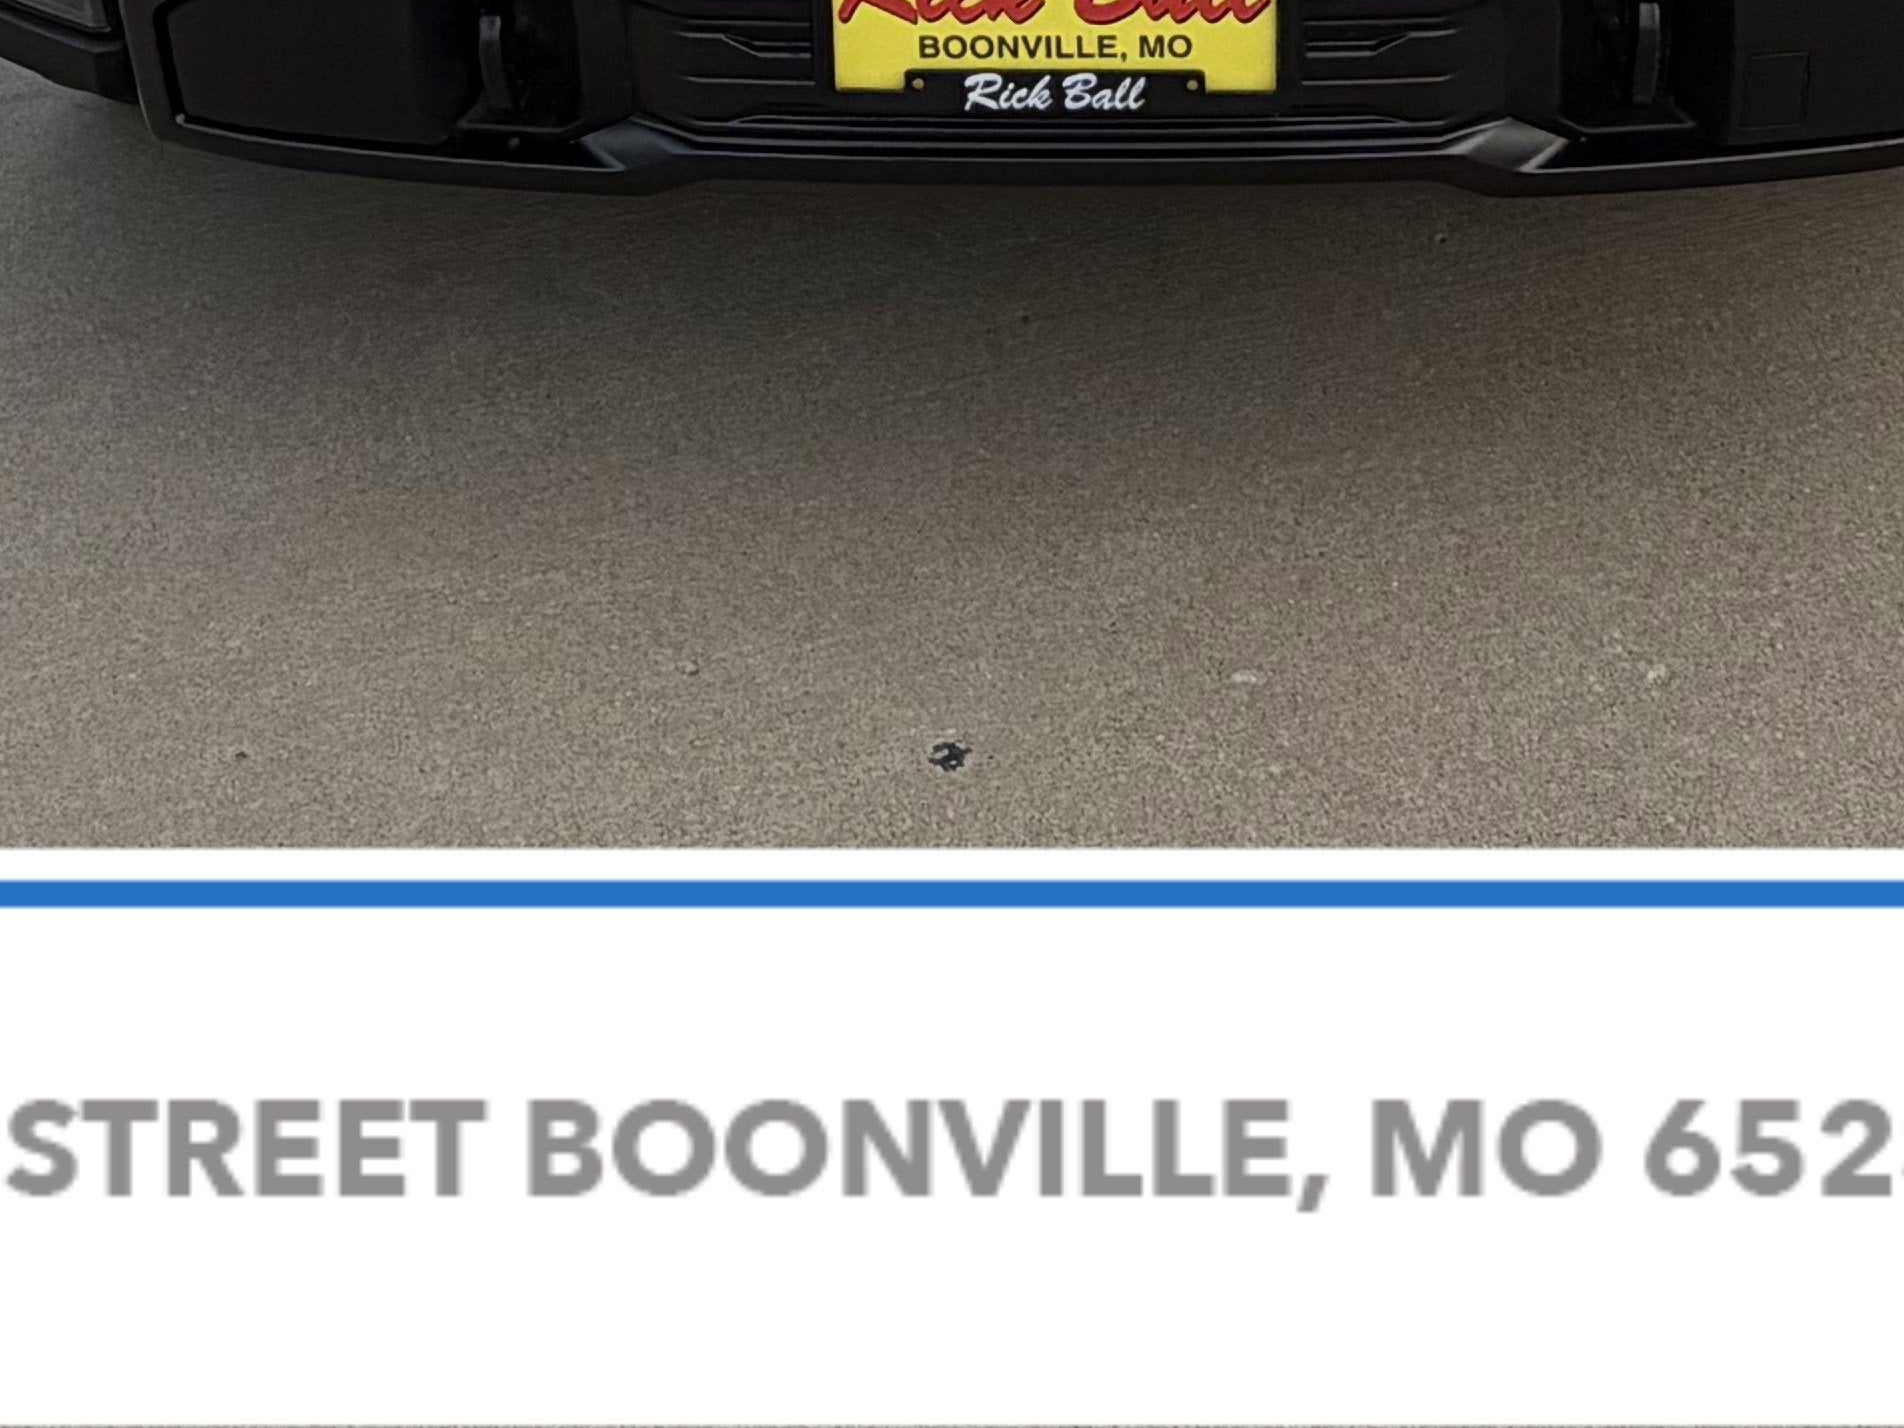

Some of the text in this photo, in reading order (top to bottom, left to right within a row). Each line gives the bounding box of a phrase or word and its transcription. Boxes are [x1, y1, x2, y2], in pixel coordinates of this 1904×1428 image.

[918, 34, 1193, 62] BOONVILLE, MO
[963, 71, 1147, 112] Rick Ball
